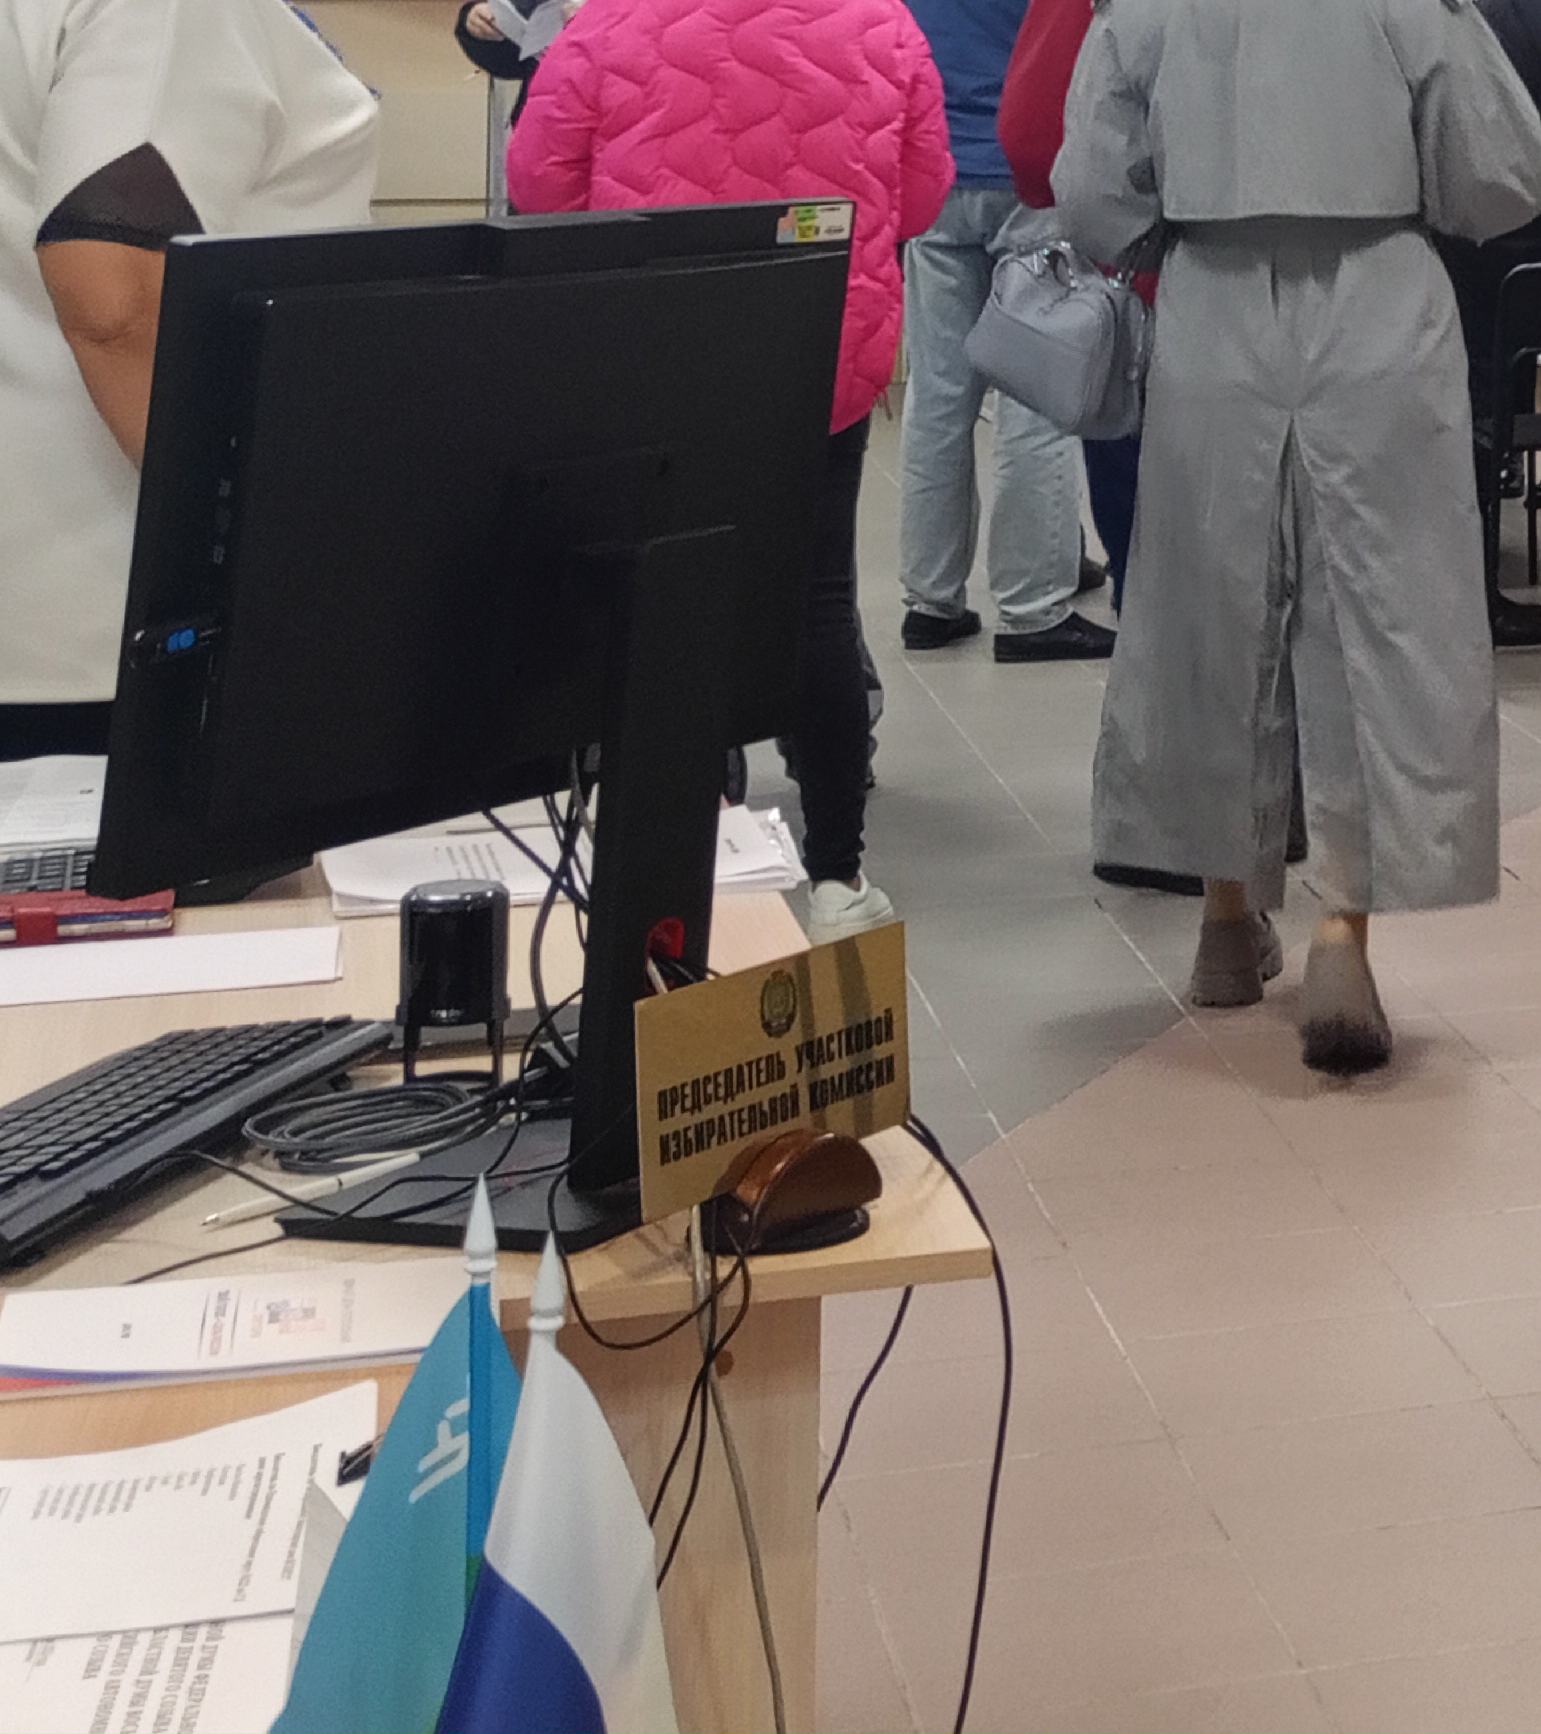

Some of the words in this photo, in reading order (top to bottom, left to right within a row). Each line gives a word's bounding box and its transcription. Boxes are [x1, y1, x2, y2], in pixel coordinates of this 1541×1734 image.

[657, 1050, 786, 1121] ПРЕДСЕДАТЕЛЬ
[795, 1007, 895, 1074] УЧАСТКОВОЙ
[659, 1083, 801, 1166] ИЗБИРАТЕЛЬНОЙ
[809, 1053, 895, 1112] КОМИССИИ
